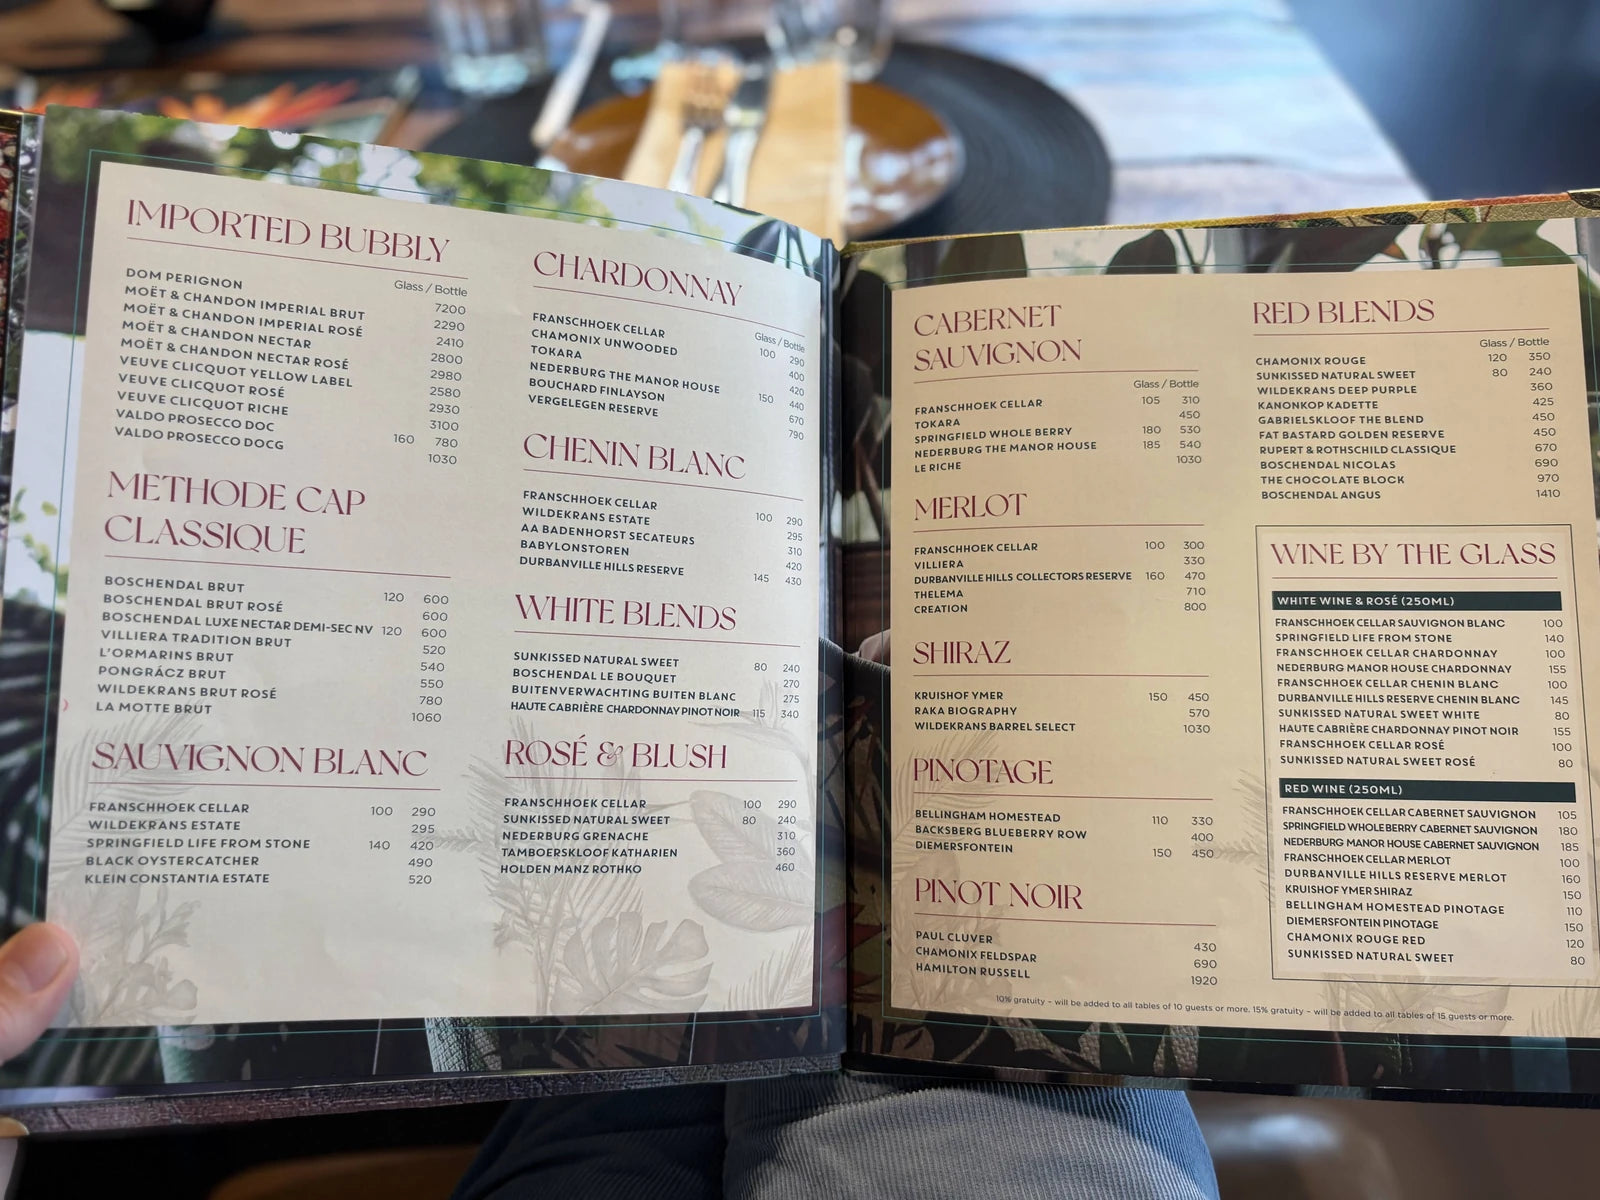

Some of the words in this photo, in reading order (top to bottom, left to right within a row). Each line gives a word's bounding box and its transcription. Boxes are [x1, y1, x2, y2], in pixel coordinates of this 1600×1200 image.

[127, 199, 311, 245] IMPORTED
[320, 223, 450, 262] BUBBLY
[126, 267, 161, 280] DOM
[165, 272, 242, 290] PERIGNON
[533, 252, 743, 306] CHARDONNAY
[393, 279, 424, 292] Glass
[425, 283, 433, 293] /
[434, 284, 468, 297] Bottle
[124, 285, 167, 298] MOËT
[170, 290, 179, 300] &
[183, 291, 256, 308] CHANDON
[260, 300, 326, 316] IMPERIAL
[329, 308, 365, 320] BRUT
[434, 302, 466, 315] 7200
[1253, 301, 1310, 324] RED
[1318, 298, 1434, 323] BLENDS
[433, 319, 465, 332] 2290
[532, 312, 620, 332] FRANSCHHOEK
[622, 324, 665, 338] CELLAR
[913, 304, 1062, 337] CABERNET
[530, 344, 582, 359] TOKARA
[759, 347, 776, 359] 100
[913, 339, 1082, 371] SAUVIGNON
[118, 373, 167, 387] VEUVE
[170, 378, 245, 394] CLICQUOT
[248, 385, 285, 398] ROSÉ
[114, 426, 164, 440] VALDO
[166, 430, 241, 446] PROSECCO
[243, 437, 284, 450] DOCG
[393, 433, 415, 444] 160
[788, 429, 804, 441] 790
[523, 433, 640, 468] CHENIN
[648, 445, 745, 479] BLANC
[1259, 445, 1304, 454] RUPERT
[1306, 445, 1314, 454] &
[1316, 445, 1388, 454] ROTHSCHILD
[1390, 444, 1456, 455] CLASSIQUE
[428, 453, 457, 465] 1030
[1176, 455, 1202, 464] 1030
[914, 464, 926, 473] LE
[928, 461, 961, 472] RICHE
[107, 471, 286, 510] METHODE
[296, 486, 365, 515] CAP
[1535, 488, 1560, 498] 1410
[914, 493, 1027, 520] MERLOT
[104, 516, 305, 554] CLASSIQUE
[520, 523, 538, 533] AA
[542, 524, 626, 539] BADENHORST
[628, 531, 695, 545] SECATEURS
[520, 539, 629, 556] BABYLONSTOREN
[1270, 543, 1344, 564] WINE
[1352, 543, 1388, 564] BY
[1396, 543, 1451, 564] THE
[1459, 542, 1556, 565] GLASS
[784, 576, 802, 586] 430
[914, 573, 984, 584] DURBANVILLE
[985, 572, 1013, 582] HILLS
[1016, 571, 1084, 581] COLLECTORS
[1085, 571, 1132, 580] RESERVE
[1145, 571, 1165, 581] 160
[1184, 571, 1206, 580] 470
[104, 575, 203, 591] BOSCHENDAL
[207, 581, 245, 593] BRUT
[383, 592, 404, 602] 120
[423, 594, 449, 605] 600
[1277, 596, 1316, 605] WHITE
[1319, 596, 1352, 605] WINE
[1355, 596, 1363, 605] &
[1366, 594, 1398, 606] ROSÉ
[1401, 596, 1454, 606] (250ML)
[515, 594, 614, 624] WHITE
[623, 600, 736, 630] BLENDS
[101, 629, 168, 642] VILLIERA
[171, 632, 251, 646] TRADITION
[255, 636, 292, 647] BRUT
[912, 640, 1010, 664] SHIRAZ
[98, 664, 184, 678] PONGRÁCZ
[188, 669, 226, 679] BRUT
[753, 662, 767, 671] 80
[782, 663, 800, 673] 240
[1276, 663, 1344, 672] NEDERBURG
[1346, 663, 1388, 672] MANOR
[1390, 664, 1429, 673] HOUSE
[1431, 664, 1512, 673] CHARDONNAY
[1548, 664, 1567, 674] 155
[511, 684, 649, 699] BUITENVERWACHTING
[653, 689, 695, 700] BUITEN
[698, 691, 736, 701] BLANC
[914, 691, 969, 700] KRUISHOF
[971, 691, 1003, 700] YMER
[1189, 708, 1210, 718] 570
[505, 734, 587, 766] ROSÉ
[596, 741, 623, 766] &
[632, 742, 726, 768] BLUSH
[91, 742, 304, 773] SAUVIGNON
[313, 747, 427, 776] BLANC
[914, 757, 1053, 784] PINOTAGE
[1284, 784, 1309, 793] RED
[1311, 784, 1345, 794] WINE
[1348, 784, 1402, 795] (250ML)
[915, 824, 981, 836] BACKSBERG
[984, 827, 1054, 838] BLUEBERRY
[1057, 829, 1087, 839] ROW
[86, 837, 185, 848] SPRINGFIELD
[187, 838, 216, 848] LIFE
[220, 838, 261, 848] FROM
[265, 838, 310, 849] STONE
[368, 840, 390, 850] 140
[409, 840, 434, 851] 420
[501, 847, 609, 857] TAMBOERSKLOOF
[611, 848, 677, 857] KATHARIEN
[775, 862, 795, 872] 460
[84, 873, 126, 884] KLEIN
[129, 873, 219, 884] CONSTANTIA
[222, 873, 269, 883] ESTATE
[915, 877, 1001, 906] PINOT
[1009, 882, 1083, 909] NOIR
[1286, 916, 1381, 927] DIEMERSFONTEIN
[1382, 918, 1439, 929] PINOTAGE
[915, 930, 944, 941] PAUL
[947, 932, 993, 944] CLUVER
[1191, 975, 1218, 986] 1920
[996, 995, 1011, 1003] 10%
[1014, 997, 1045, 1006] gratuity
[1084, 1000, 1109, 1008] added
[1185, 1004, 1213, 1012] guests
[1270, 1007, 1304, 1016] gratuity
[1398, 1011, 1423, 1019] tables
[1437, 1012, 1445, 1020] 15
